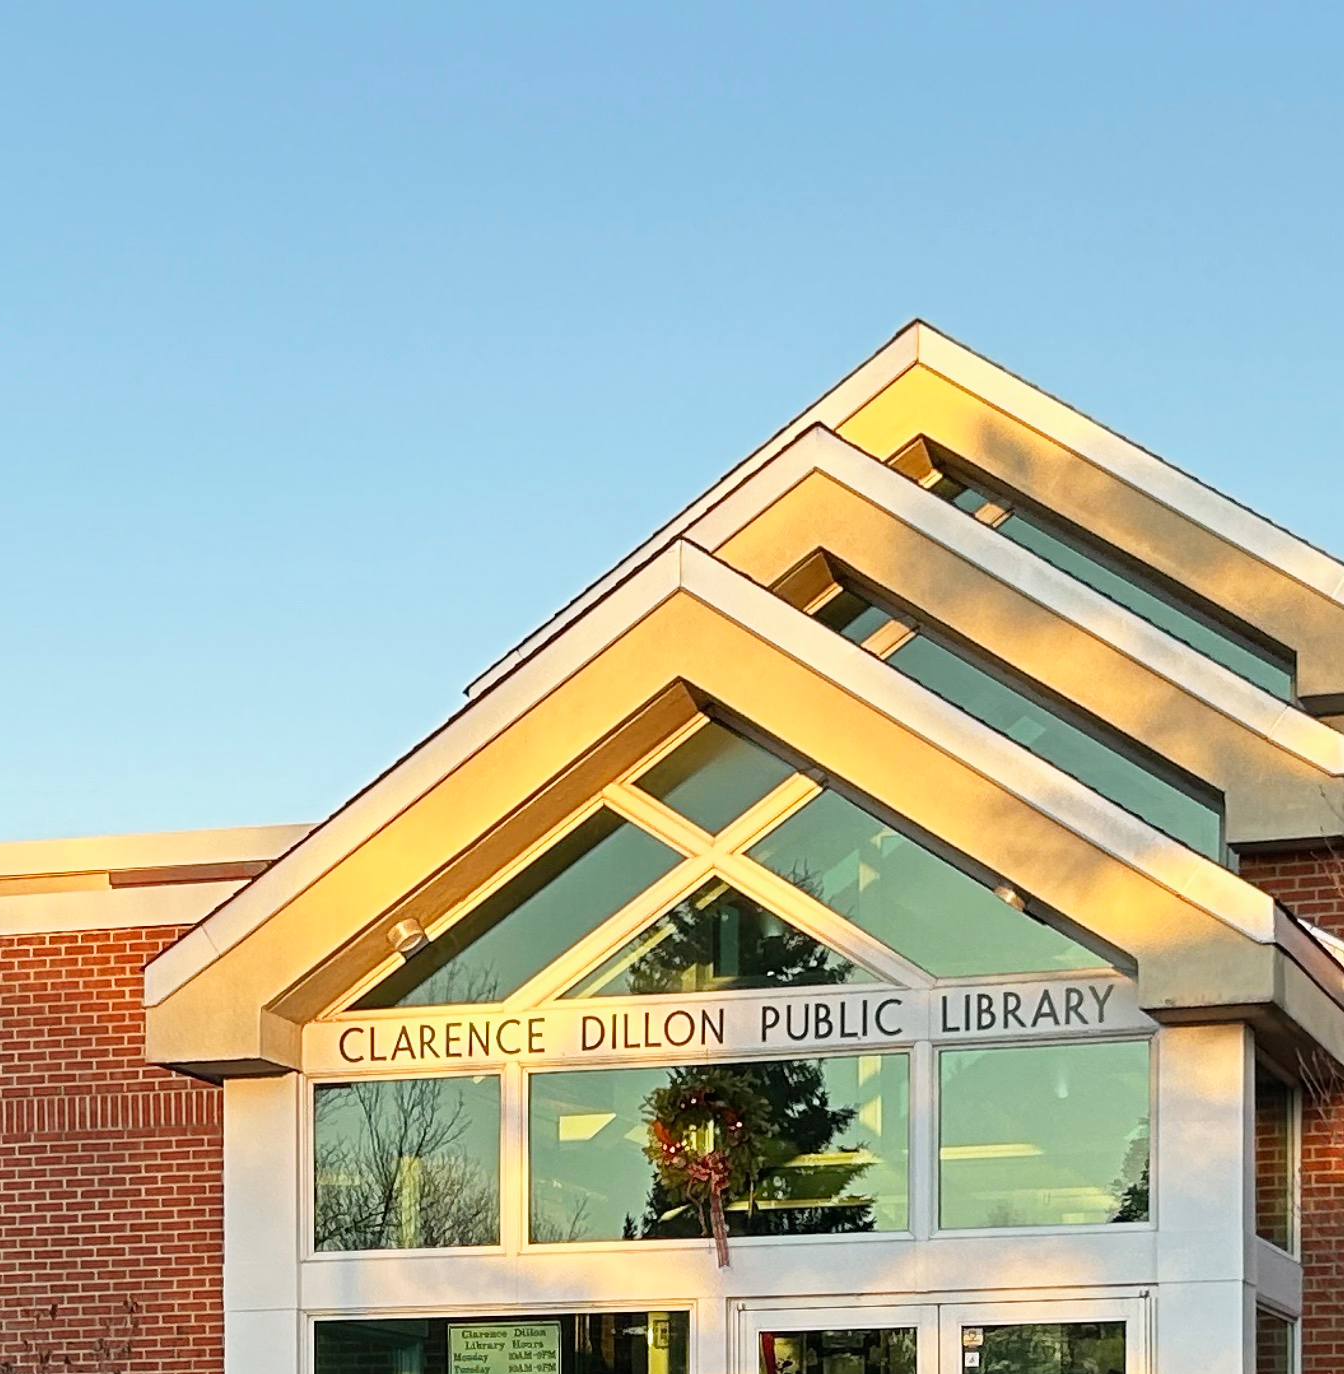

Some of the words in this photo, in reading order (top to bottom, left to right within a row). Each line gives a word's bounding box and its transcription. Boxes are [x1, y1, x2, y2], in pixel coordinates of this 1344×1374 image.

[339, 1017, 546, 1063] CLARENCE
[581, 1008, 725, 1051] DILLON
[761, 998, 903, 1042] PUBLIC
[941, 984, 1115, 1032] LIBRARY
[461, 1330, 508, 1339] Clarence
[514, 1328, 547, 1337] Dillon
[464, 1341, 506, 1351] Library
[512, 1340, 544, 1349] Hours
